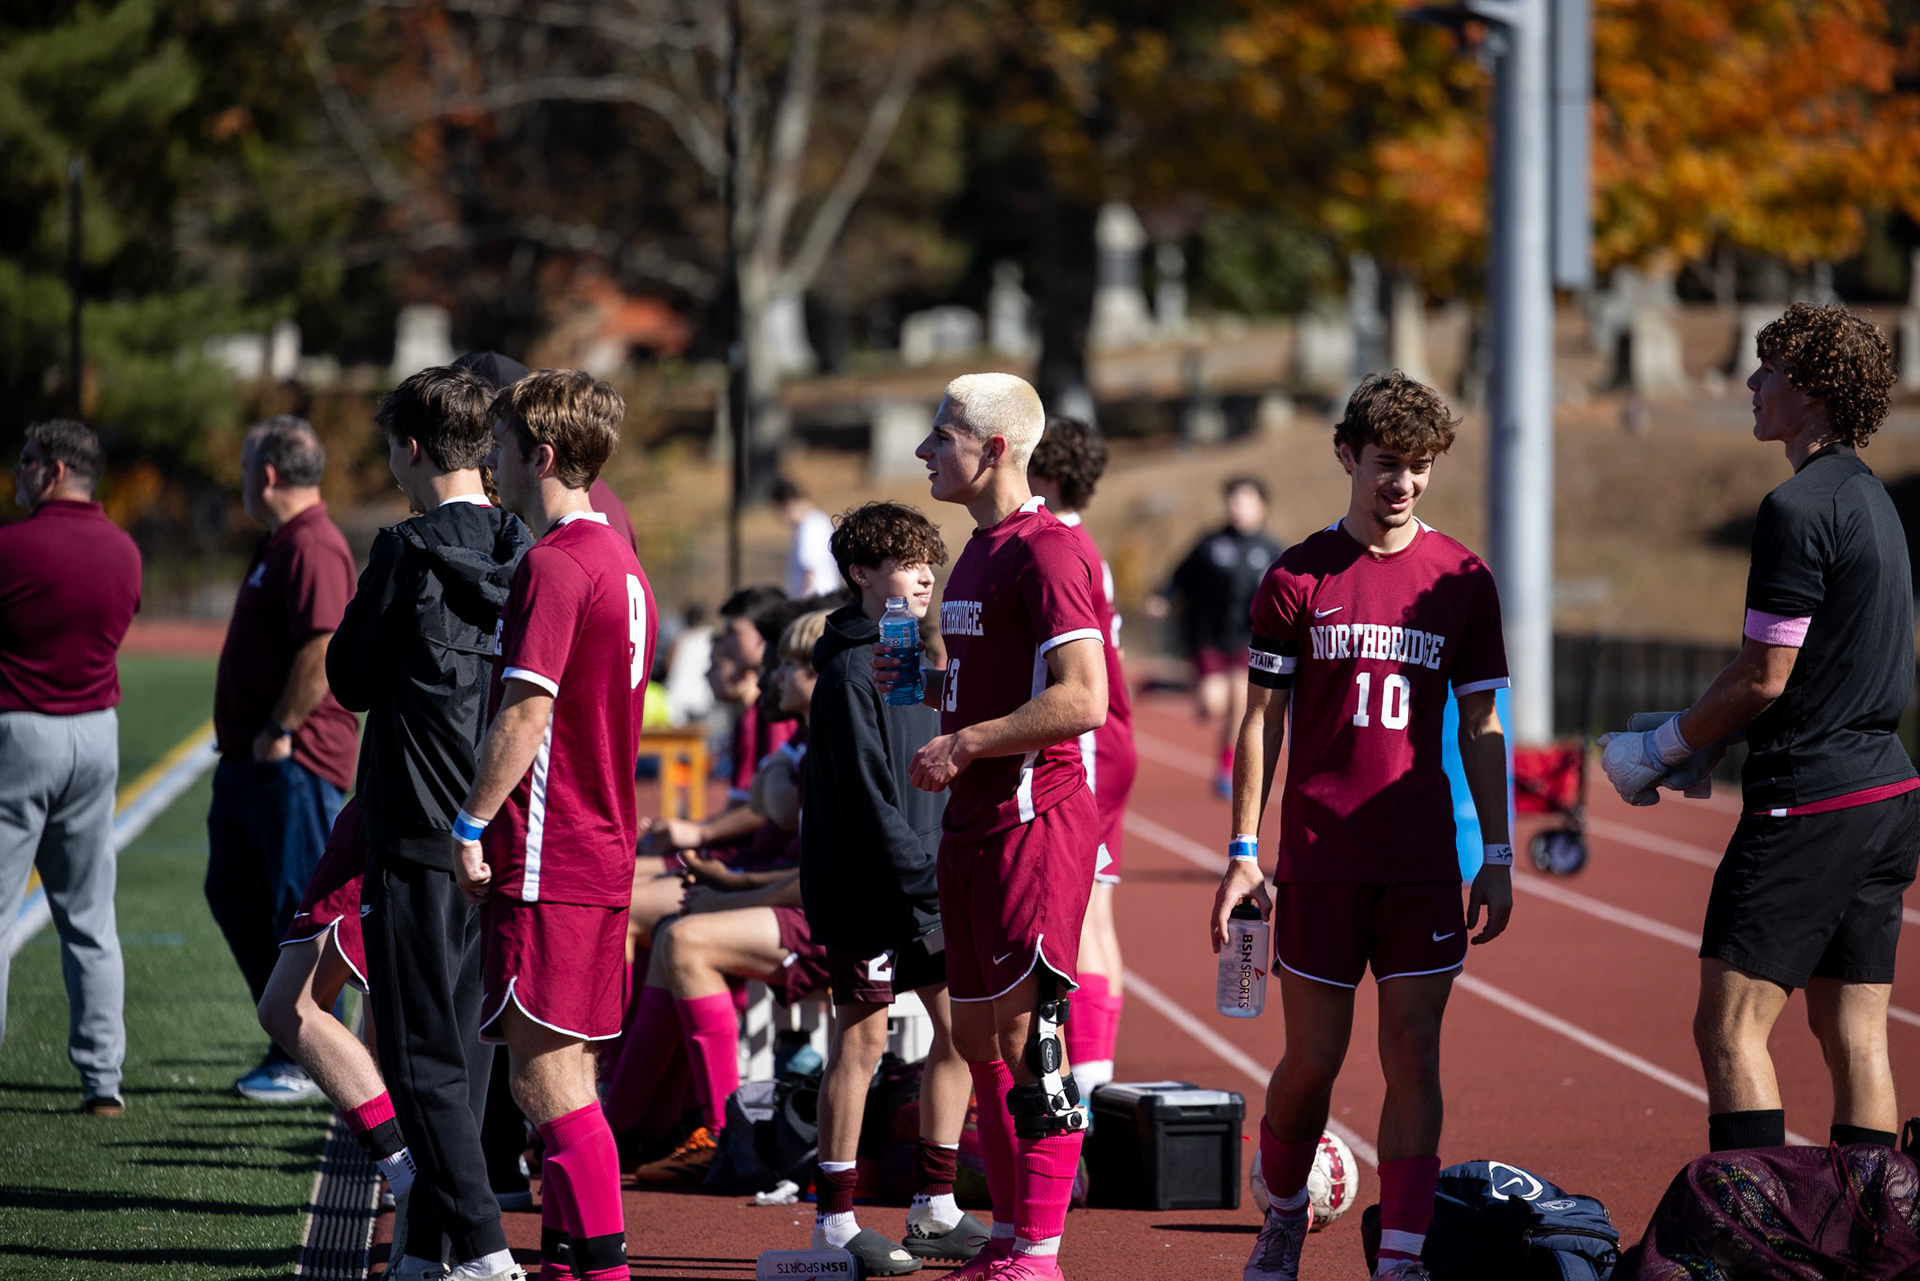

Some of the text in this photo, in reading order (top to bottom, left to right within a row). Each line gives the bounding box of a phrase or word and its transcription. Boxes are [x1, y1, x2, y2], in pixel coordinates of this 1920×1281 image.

[626, 573, 647, 690] 9
[1309, 623, 1445, 671] NORTHBRIDGE
[941, 658, 961, 712] 3
[1250, 652, 1274, 669] PTAIN
[1353, 672, 1411, 730] 10
[1238, 964, 1252, 1009] SPORTS
